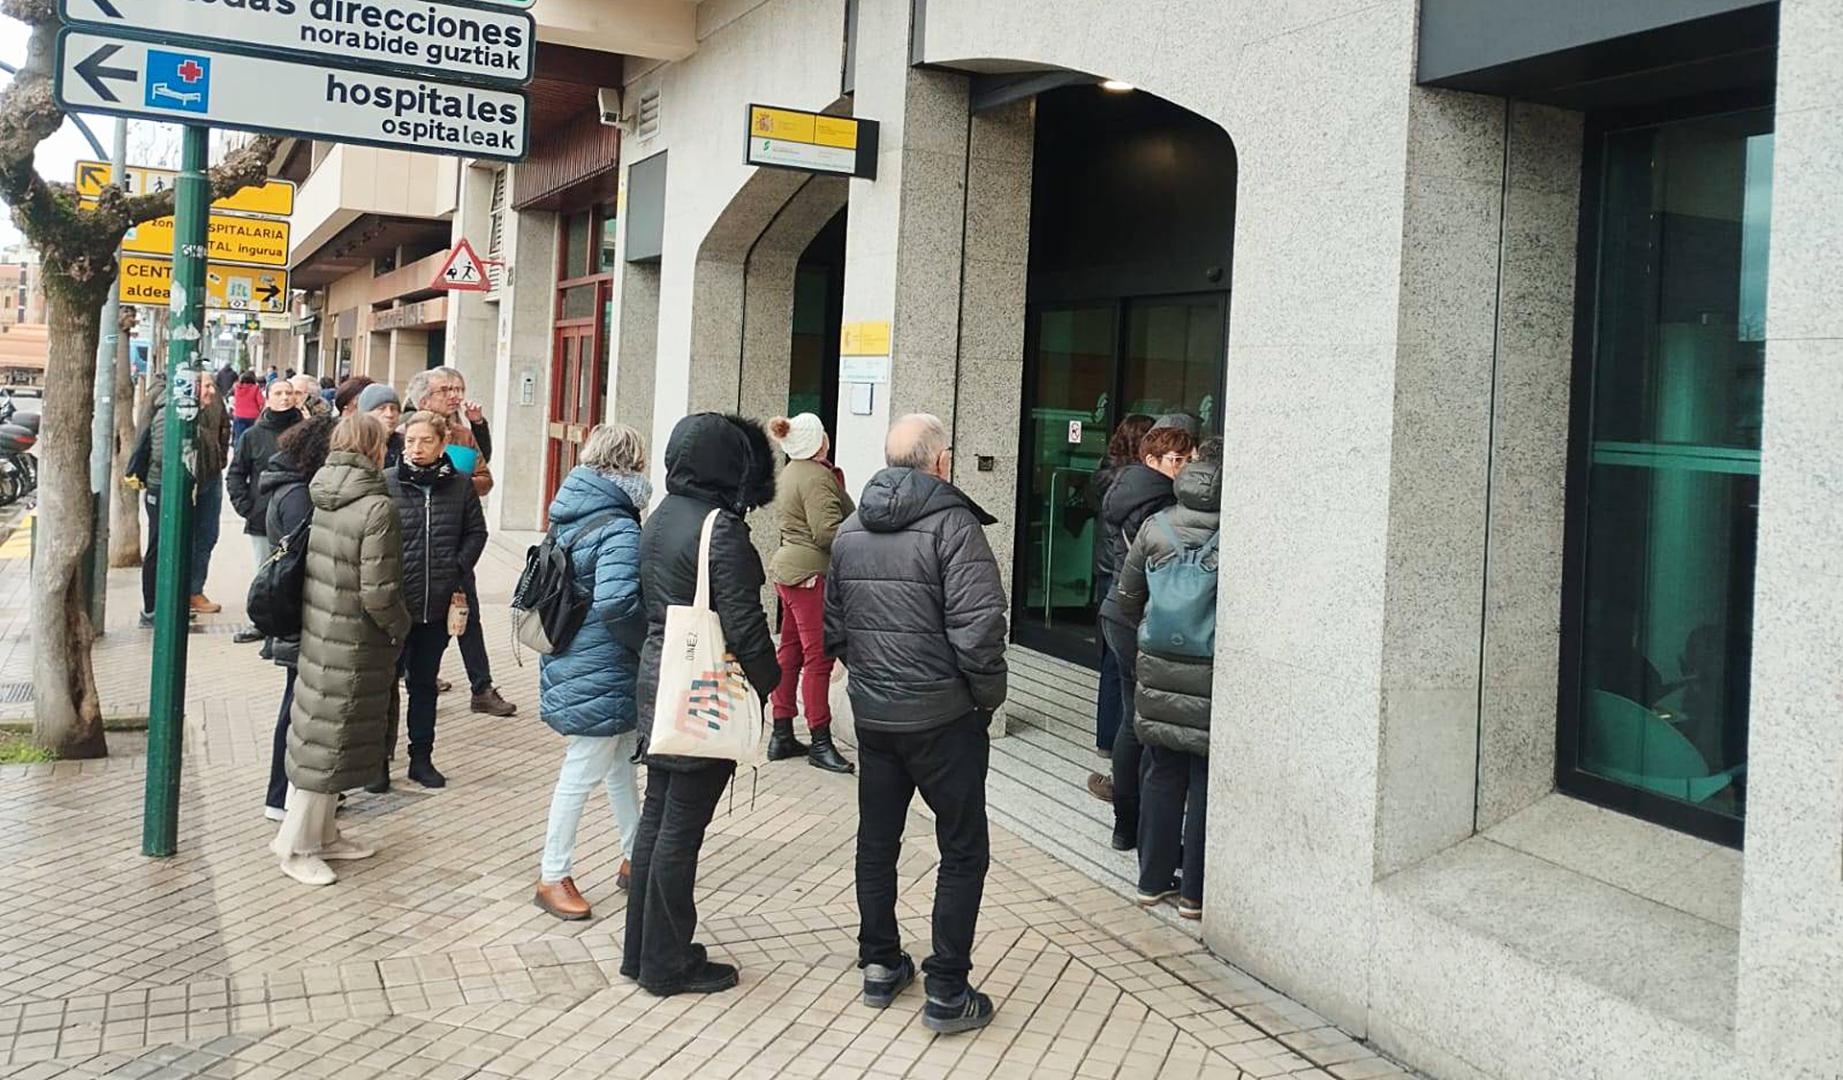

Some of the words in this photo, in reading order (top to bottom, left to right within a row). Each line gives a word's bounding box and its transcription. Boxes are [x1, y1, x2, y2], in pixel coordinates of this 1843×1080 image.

[310, 0, 523, 48] direcciones
[300, 24, 419, 56] norabide
[426, 44, 521, 70] guztiak
[326, 74, 518, 125] hospitales
[382, 118, 516, 150] ospitaleak
[151, 219, 174, 228] zon
[207, 222, 284, 240] SPITALARIA
[207, 240, 232, 252] TAL
[238, 243, 283, 257] ingurua
[126, 264, 173, 278] CENT
